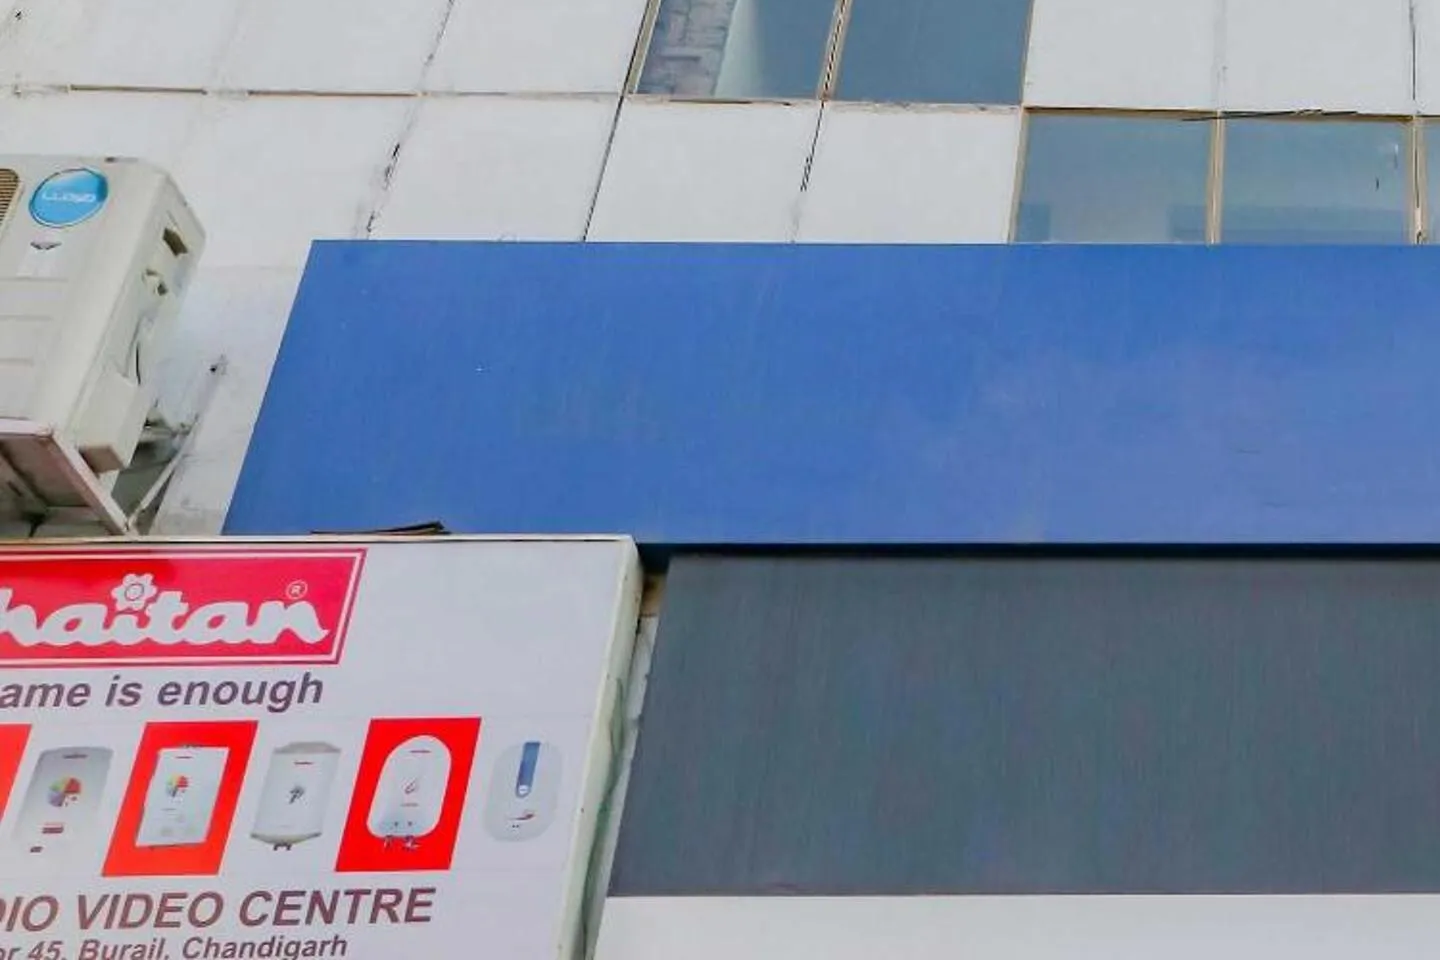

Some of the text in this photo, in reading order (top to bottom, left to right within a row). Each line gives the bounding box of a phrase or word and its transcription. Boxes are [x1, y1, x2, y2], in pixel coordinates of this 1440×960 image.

[0, 671, 324, 713] ame is enough
[0, 887, 437, 933] IO VIDEO CENTRE
[182, 934, 348, 960] Chandigarh
